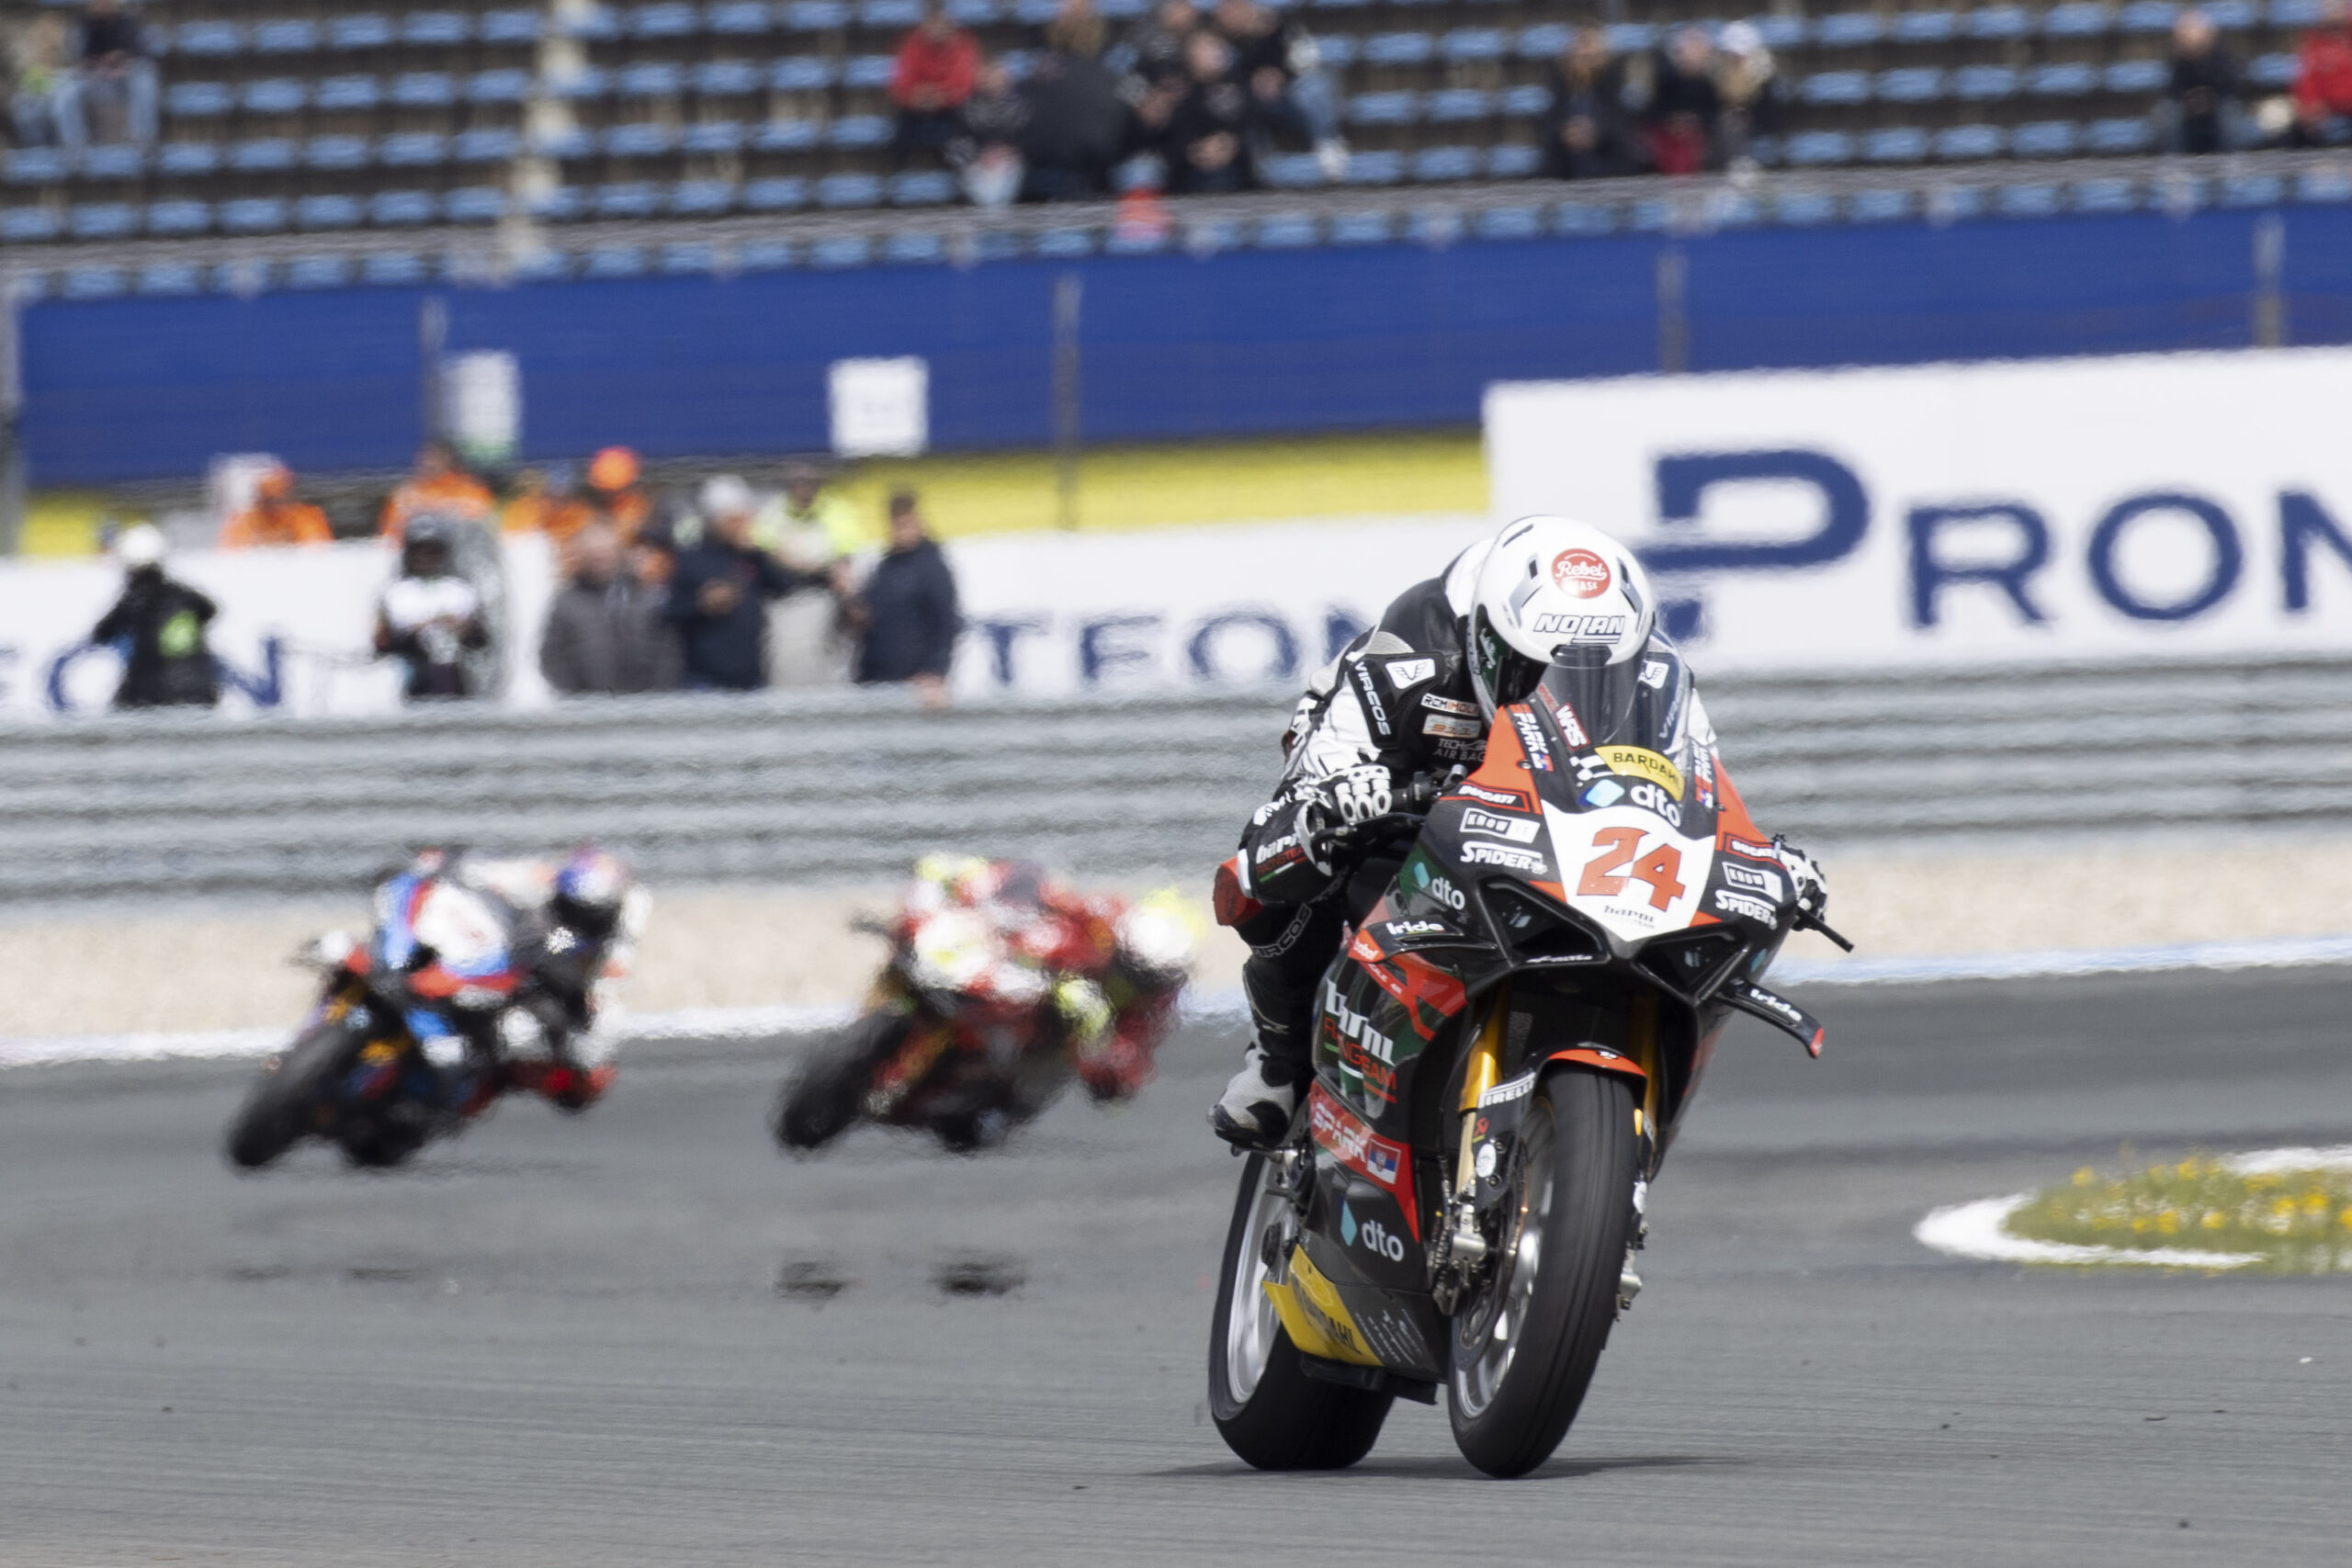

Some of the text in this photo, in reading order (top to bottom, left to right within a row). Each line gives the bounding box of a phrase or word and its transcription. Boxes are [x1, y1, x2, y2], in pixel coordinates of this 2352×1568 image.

[1532, 613, 1625, 644] NOLAN
[1354, 661, 1391, 735] VIRCOS
[1458, 784, 1517, 805] DUCATI
[1630, 784, 1681, 827] dto
[1460, 840, 1544, 870] SPIDER
[1577, 826, 1686, 912] 24
[1431, 876, 1465, 910] dto
[1715, 889, 1777, 924] SPIDER
[1362, 1219, 1404, 1262] dto
